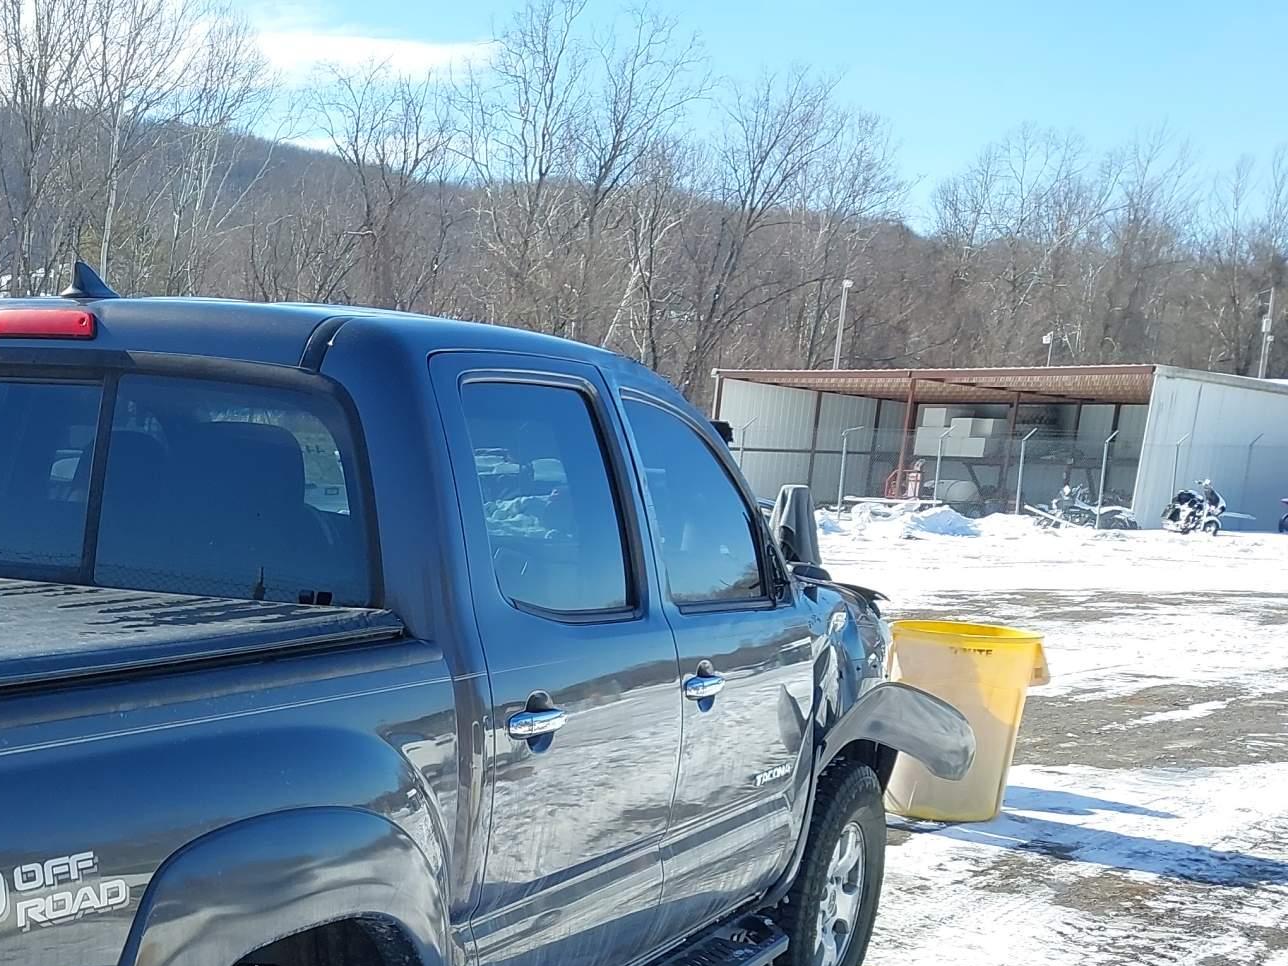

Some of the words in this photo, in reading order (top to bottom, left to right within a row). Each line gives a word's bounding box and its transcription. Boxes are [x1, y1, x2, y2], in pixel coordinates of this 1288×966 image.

[755, 762, 792, 787] TACOMA
[13, 850, 99, 891] OFF
[16, 879, 130, 932] ROAD
